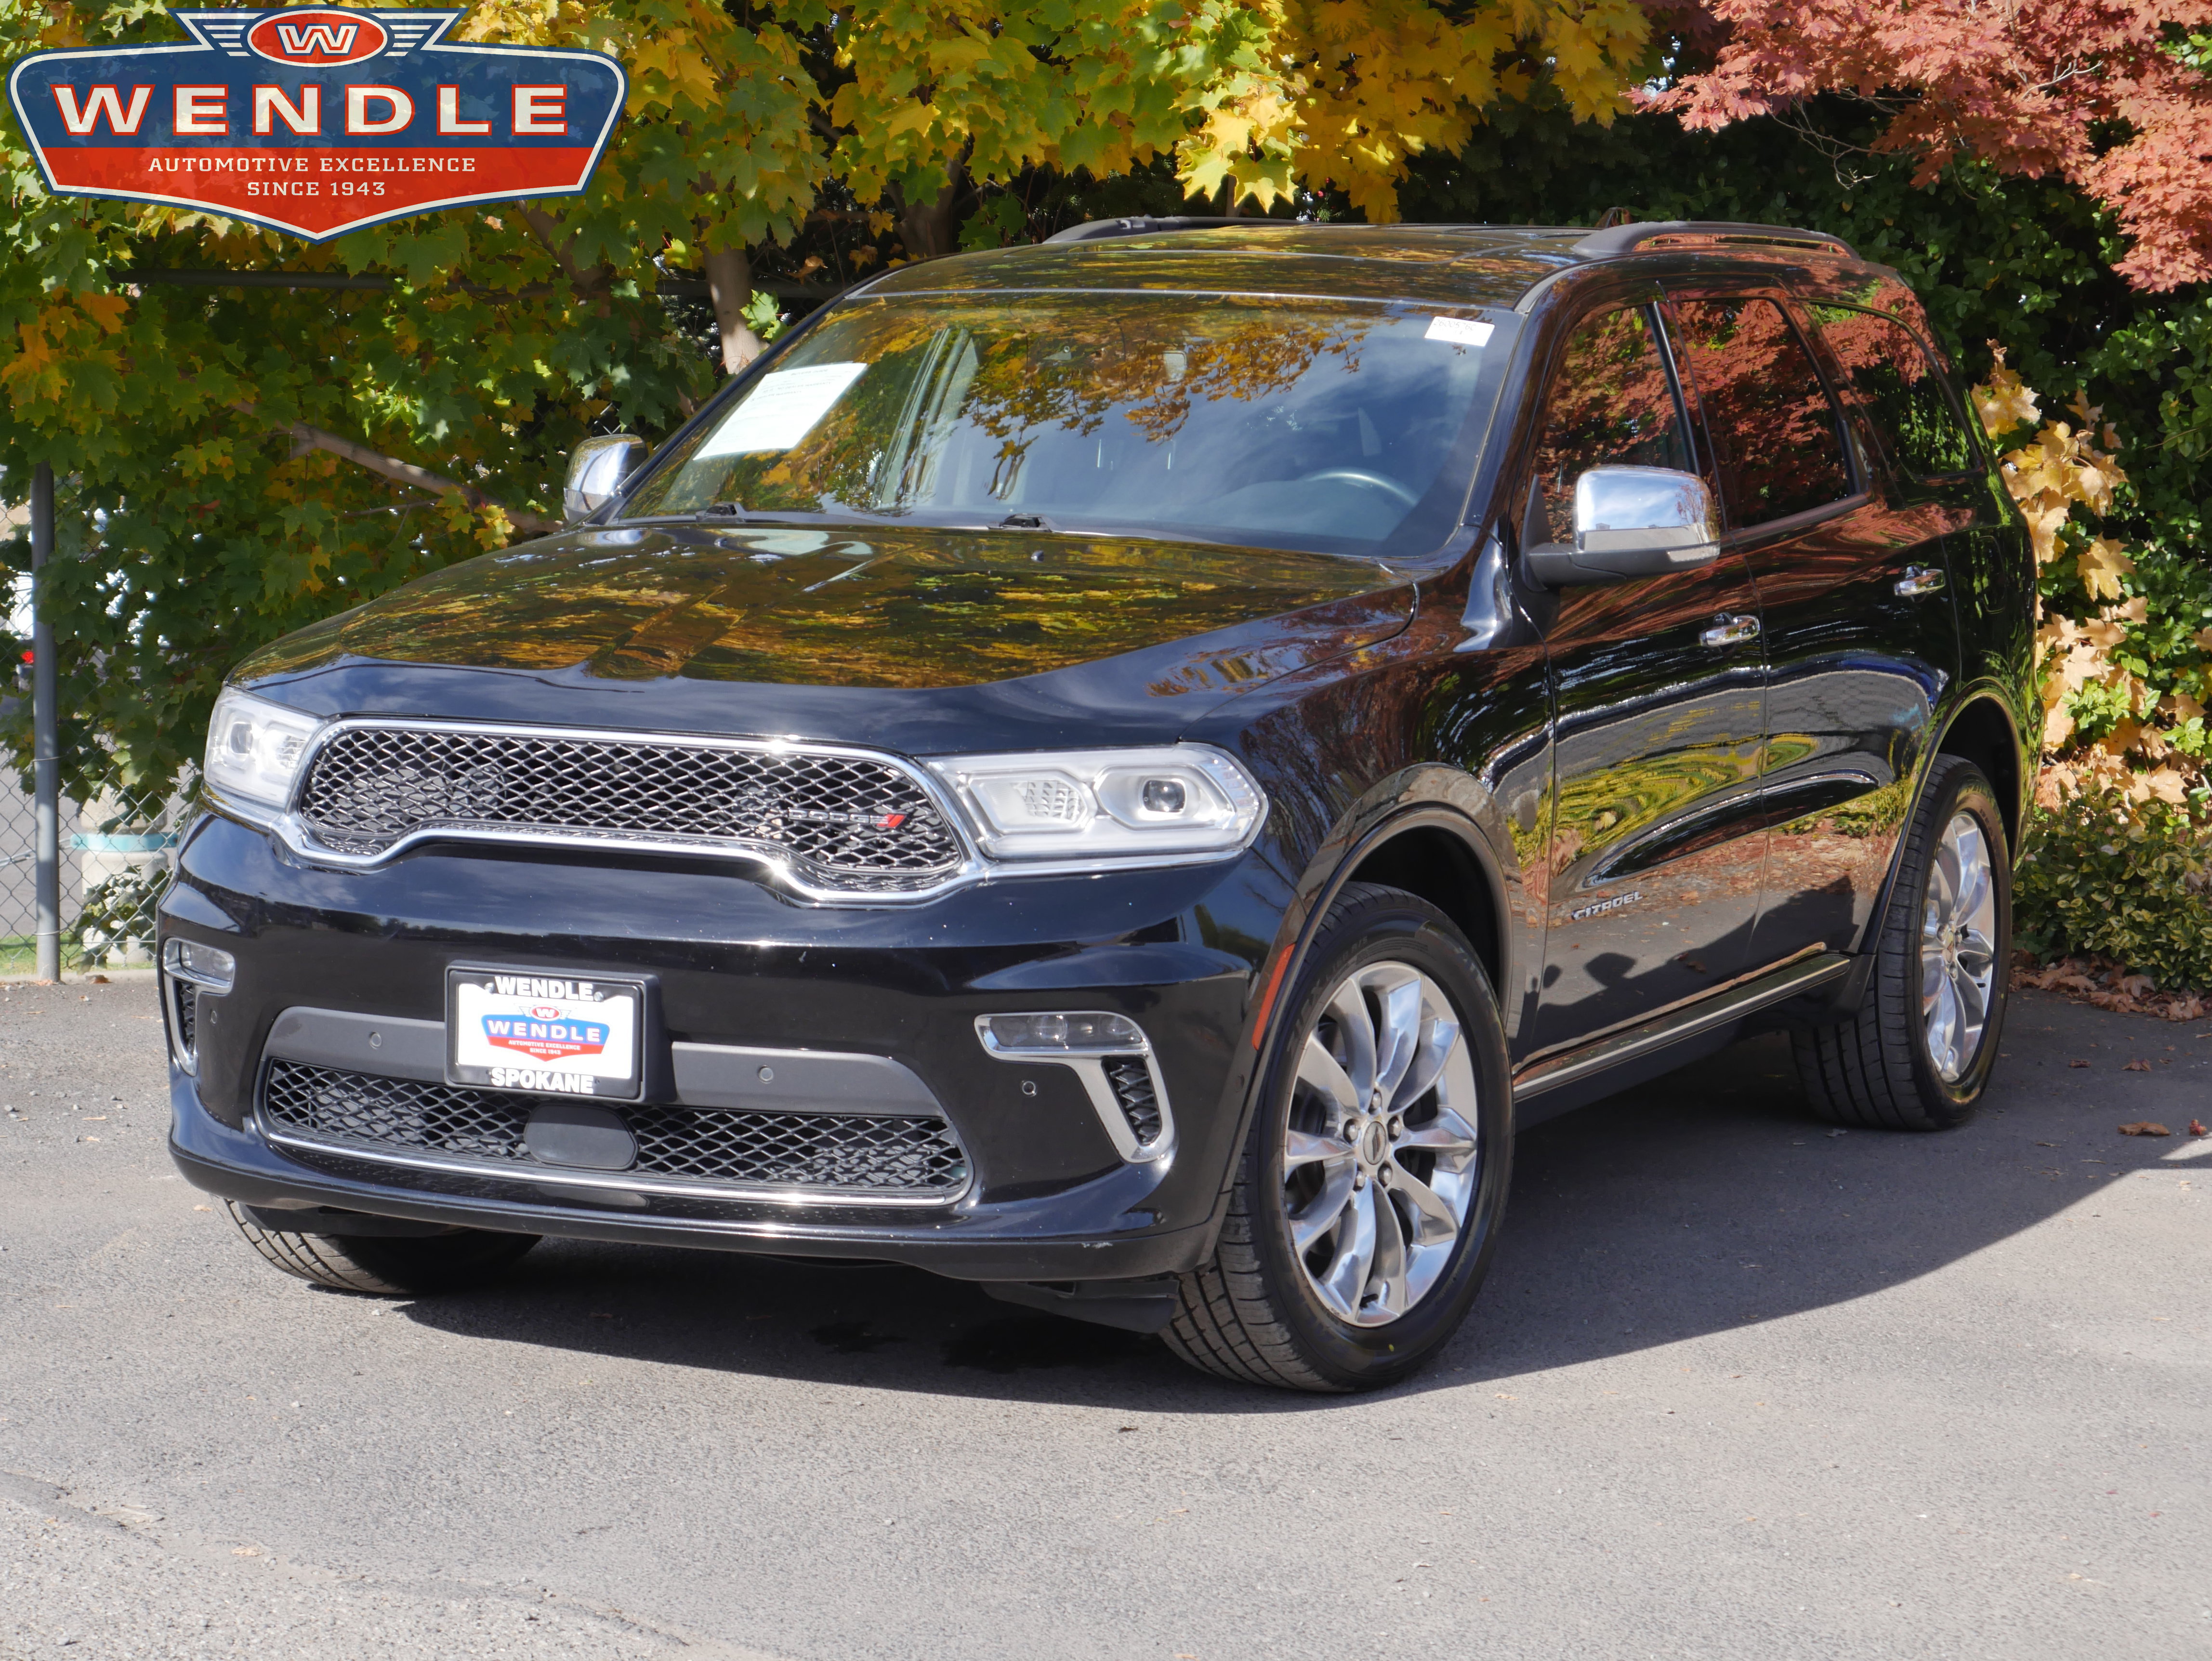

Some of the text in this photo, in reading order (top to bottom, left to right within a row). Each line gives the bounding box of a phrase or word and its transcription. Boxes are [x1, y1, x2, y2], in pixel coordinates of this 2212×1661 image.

[788, 808, 889, 824] DODGE
[1571, 891, 1643, 920] CITADEL
[494, 976, 593, 1001] WENDLE
[487, 1019, 600, 1042] WENDLE
[508, 1040, 581, 1051] AUTOMOTIVE EXCELLENCE
[491, 1067, 594, 1094] SPOKANE
